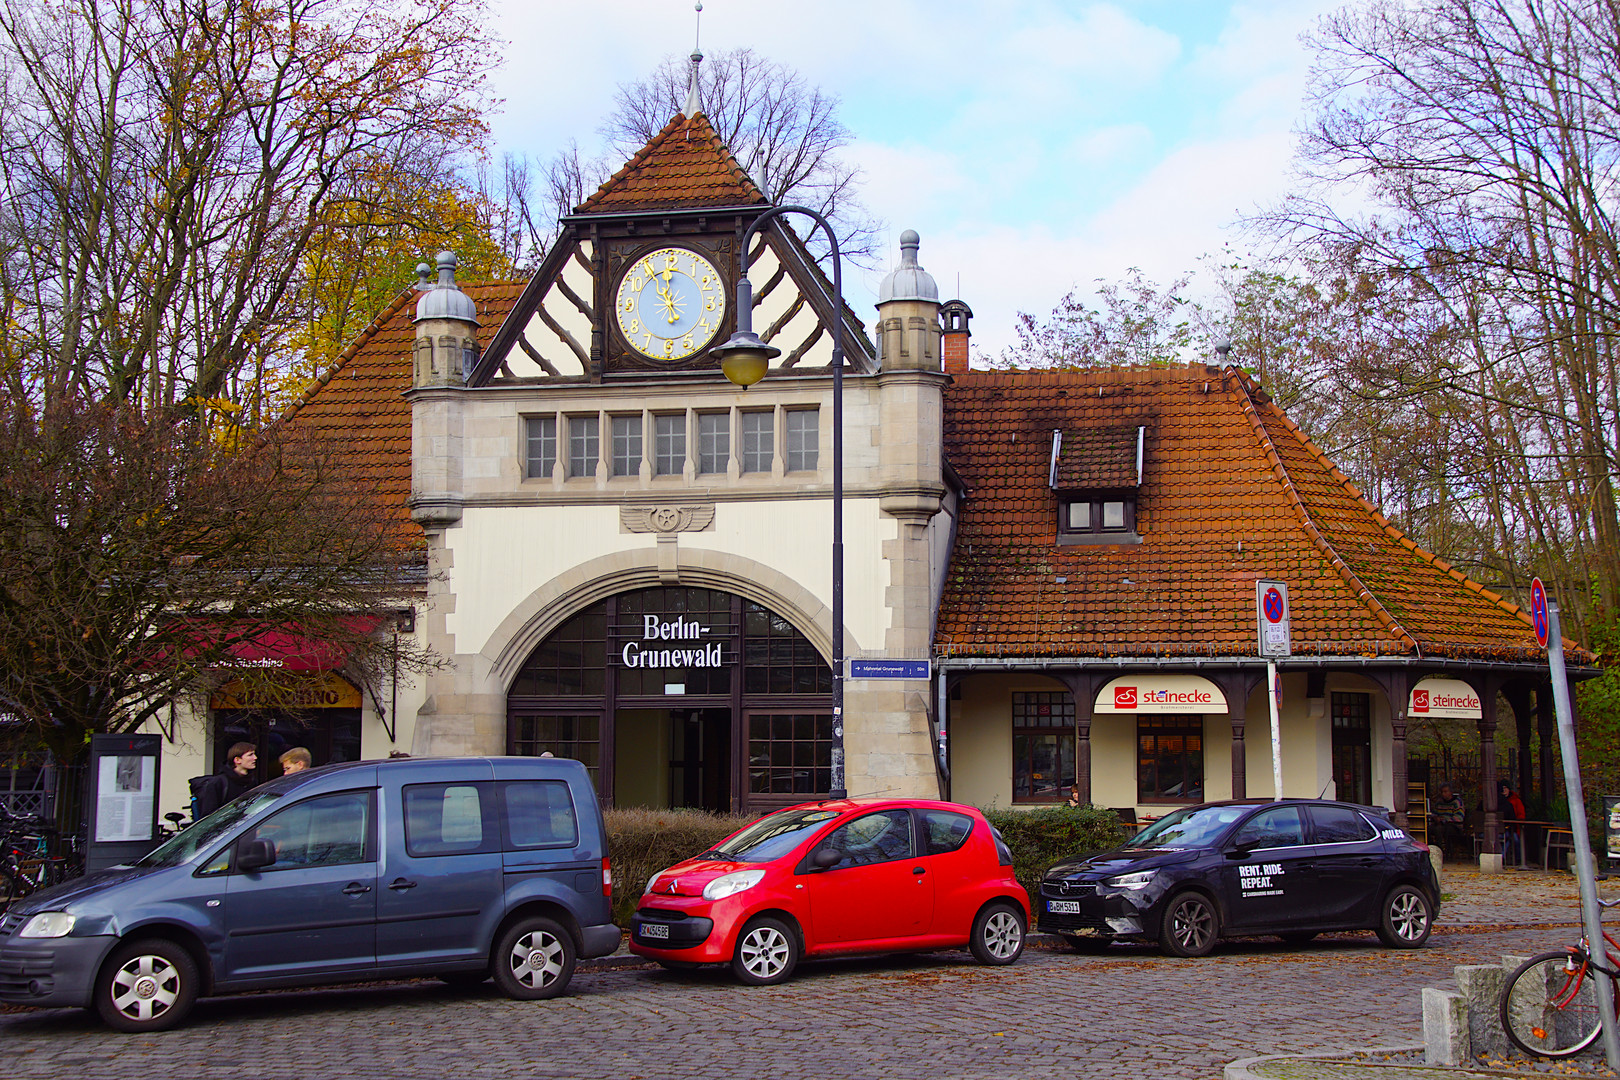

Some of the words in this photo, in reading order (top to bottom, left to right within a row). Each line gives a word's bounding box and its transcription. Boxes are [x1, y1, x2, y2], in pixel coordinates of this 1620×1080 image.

[663, 255, 679, 271] 12
[690, 262, 697, 277] 1
[631, 276, 643, 292] 10
[702, 275, 713, 291] 2
[625, 297, 635, 313] 9
[706, 296, 716, 312] 3
[630, 319, 639, 334] 8
[699, 318, 710, 334] 4
[643, 334, 652, 349] 7
[663, 339, 674, 354] 6
[683, 334, 694, 349] 5
[622, 641, 722, 668] Grunewald
[1433, 693, 1479, 708] steinecke
[1239, 865, 1263, 877] RENT.
[1262, 863, 1285, 875] RIDE.
[1241, 876, 1274, 889] REPEAT.
